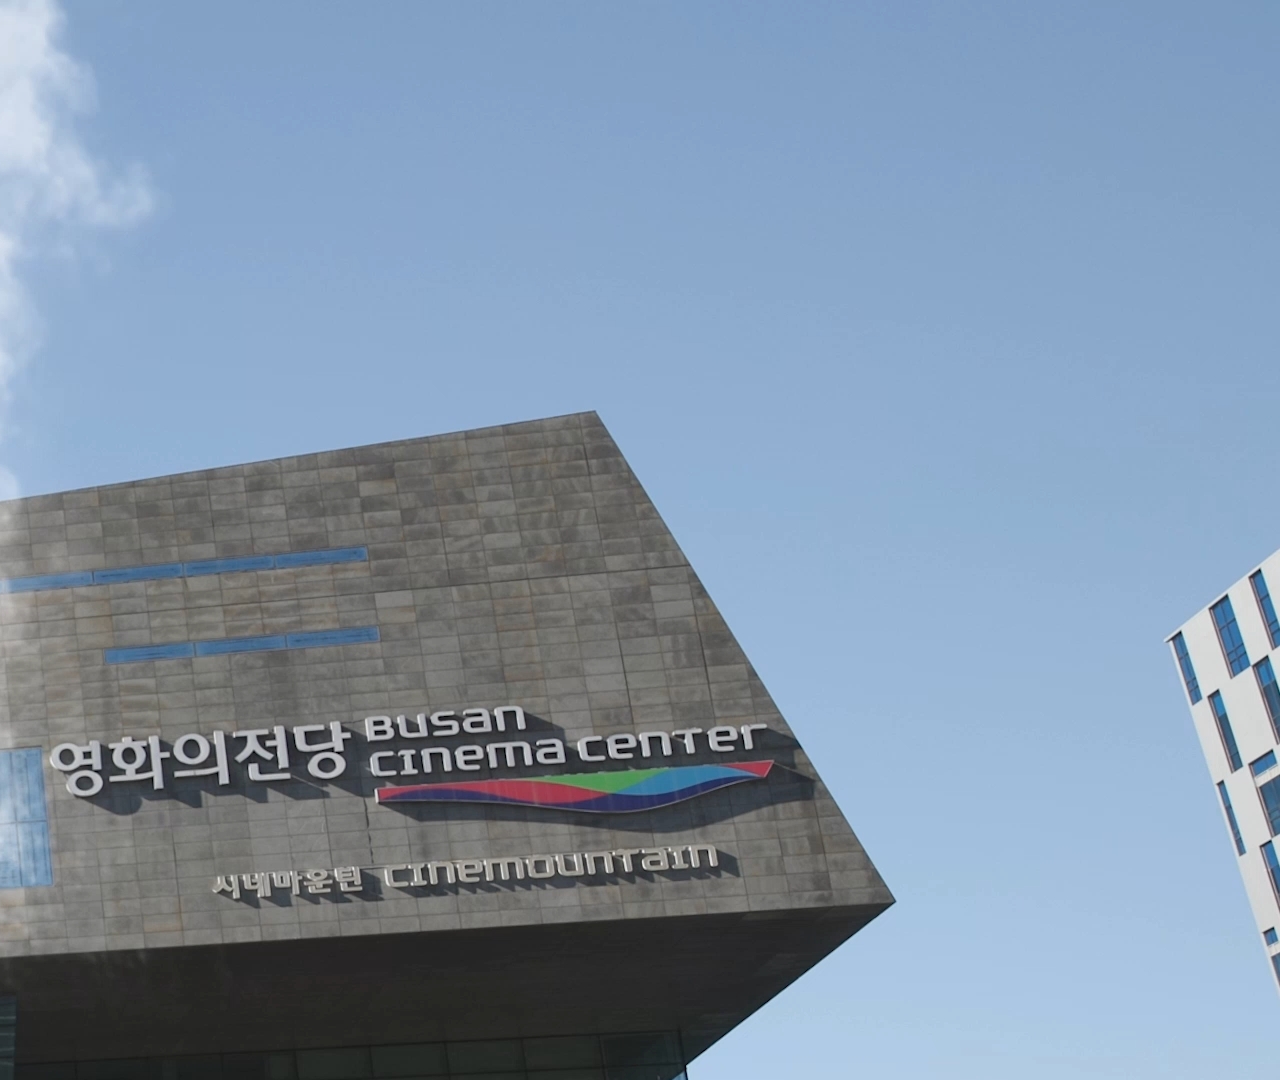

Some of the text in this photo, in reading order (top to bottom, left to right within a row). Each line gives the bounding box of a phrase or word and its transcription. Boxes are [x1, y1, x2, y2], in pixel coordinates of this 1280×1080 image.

[365, 705, 526, 742] Busan
[49, 720, 352, 797] 영화의전당
[212, 865, 363, 900] 시네마운틴
